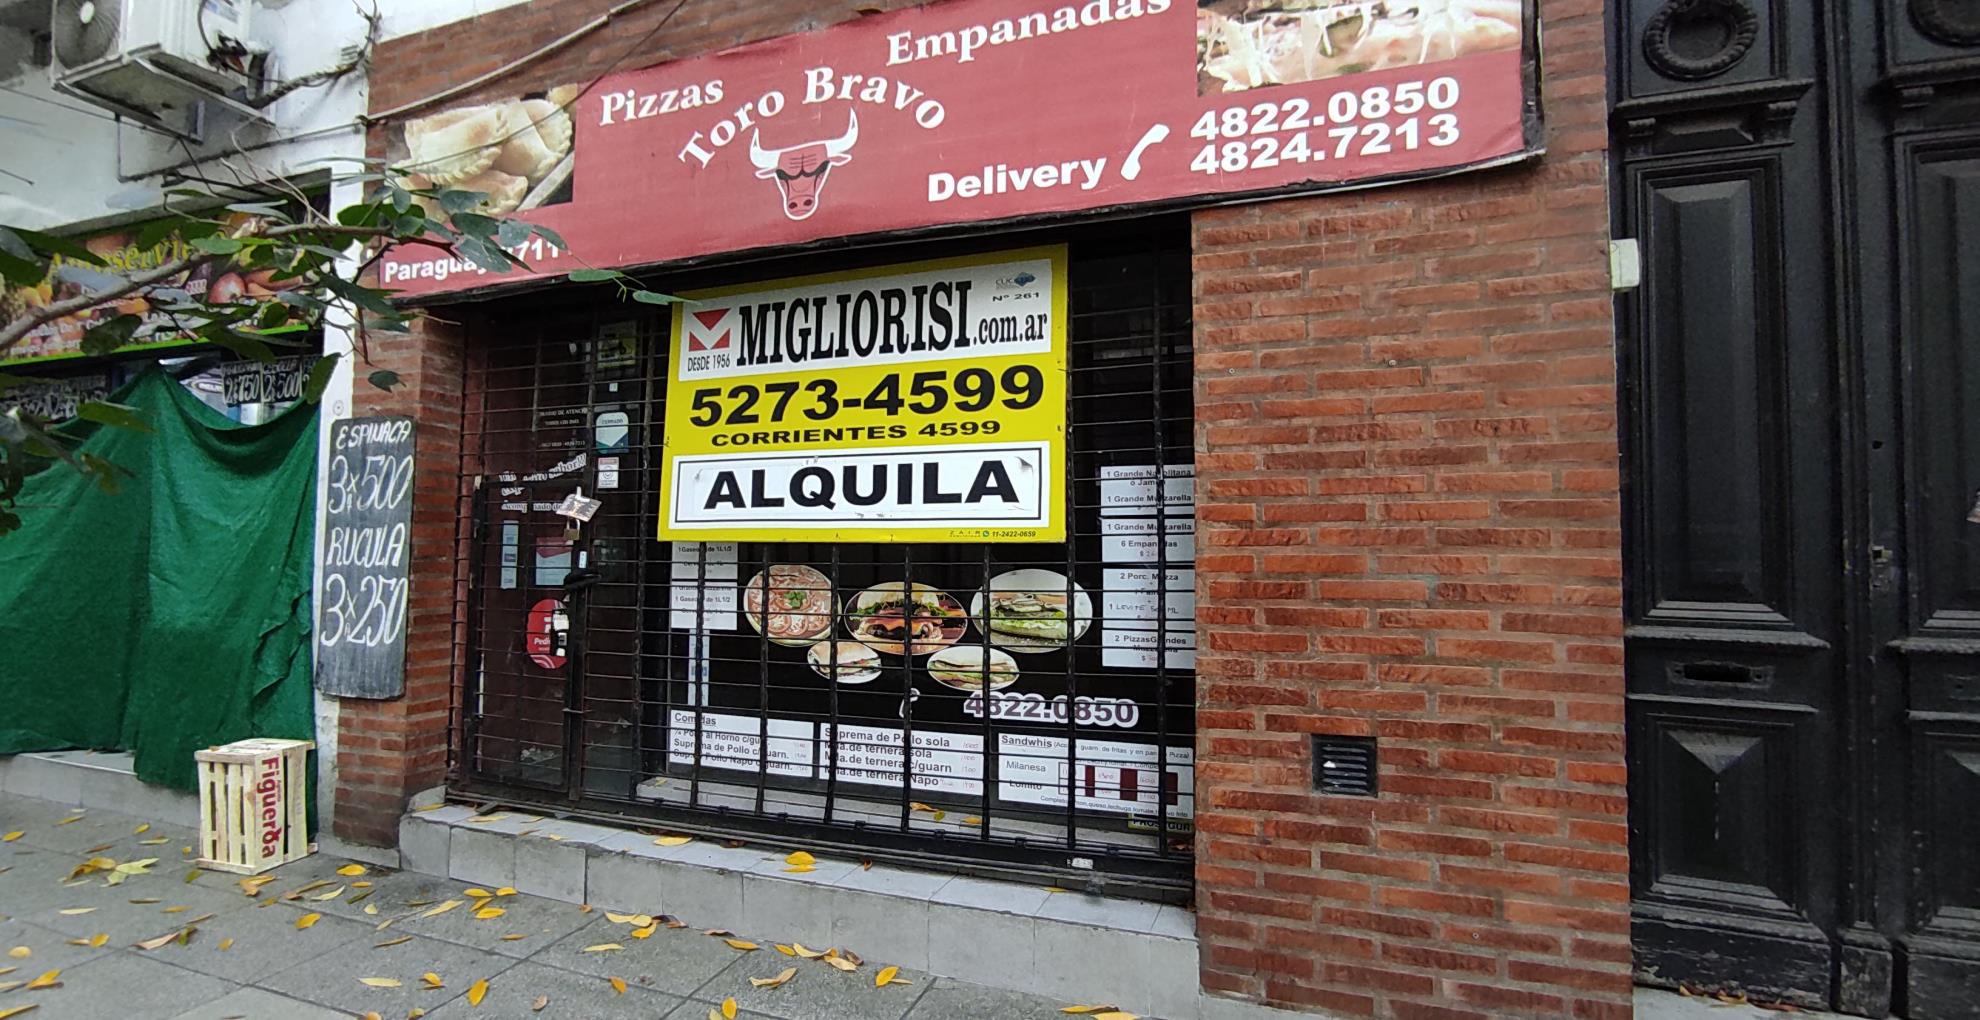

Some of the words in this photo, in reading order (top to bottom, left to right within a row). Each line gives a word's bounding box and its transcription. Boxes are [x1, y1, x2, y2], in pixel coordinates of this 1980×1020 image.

[886, 0, 1171, 66] Empanadas
[599, 79, 724, 126] Pizzas
[1190, 76, 1460, 141] 4822.0850
[678, 90, 785, 169] Toro
[802, 66, 945, 129] Bravo
[1190, 113, 1460, 175] 4824.7213
[928, 156, 1107, 202] Delivery
[501, 239, 559, 265] 711
[1014, 292, 1039, 300] 261
[688, 355, 710, 372] DESDE
[713, 353, 730, 369] 1956
[690, 364, 1044, 427] 5273-4599
[336, 420, 412, 449] ESPINACA
[711, 425, 907, 447] CORRIENTES
[918, 420, 1001, 437] 4599
[1146, 469, 1192, 477] Naolitana
[703, 460, 1020, 510] ALQUILA
[1146, 494, 1192, 502] Muzarella
[325, 522, 406, 567] RUCULA
[1114, 634, 1120, 642] 2
[674, 712, 717, 725] Comdas
[964, 691, 1138, 727] 4822.0850
[674, 738, 712, 750] Suprma
[714, 743, 724, 751] de
[727, 744, 750, 754] Pollo
[752, 747, 790, 759] c/uarn.
[715, 732, 740, 742] Horno
[825, 727, 873, 741] Sprema
[876, 732, 890, 742] de
[925, 736, 950, 748] sola
[1001, 735, 1052, 748] Sandwhis
[865, 755, 904, 768] ternera
[1006, 760, 1047, 772] Milanesa
[1133, 818, 1191, 831] PROSGUR
